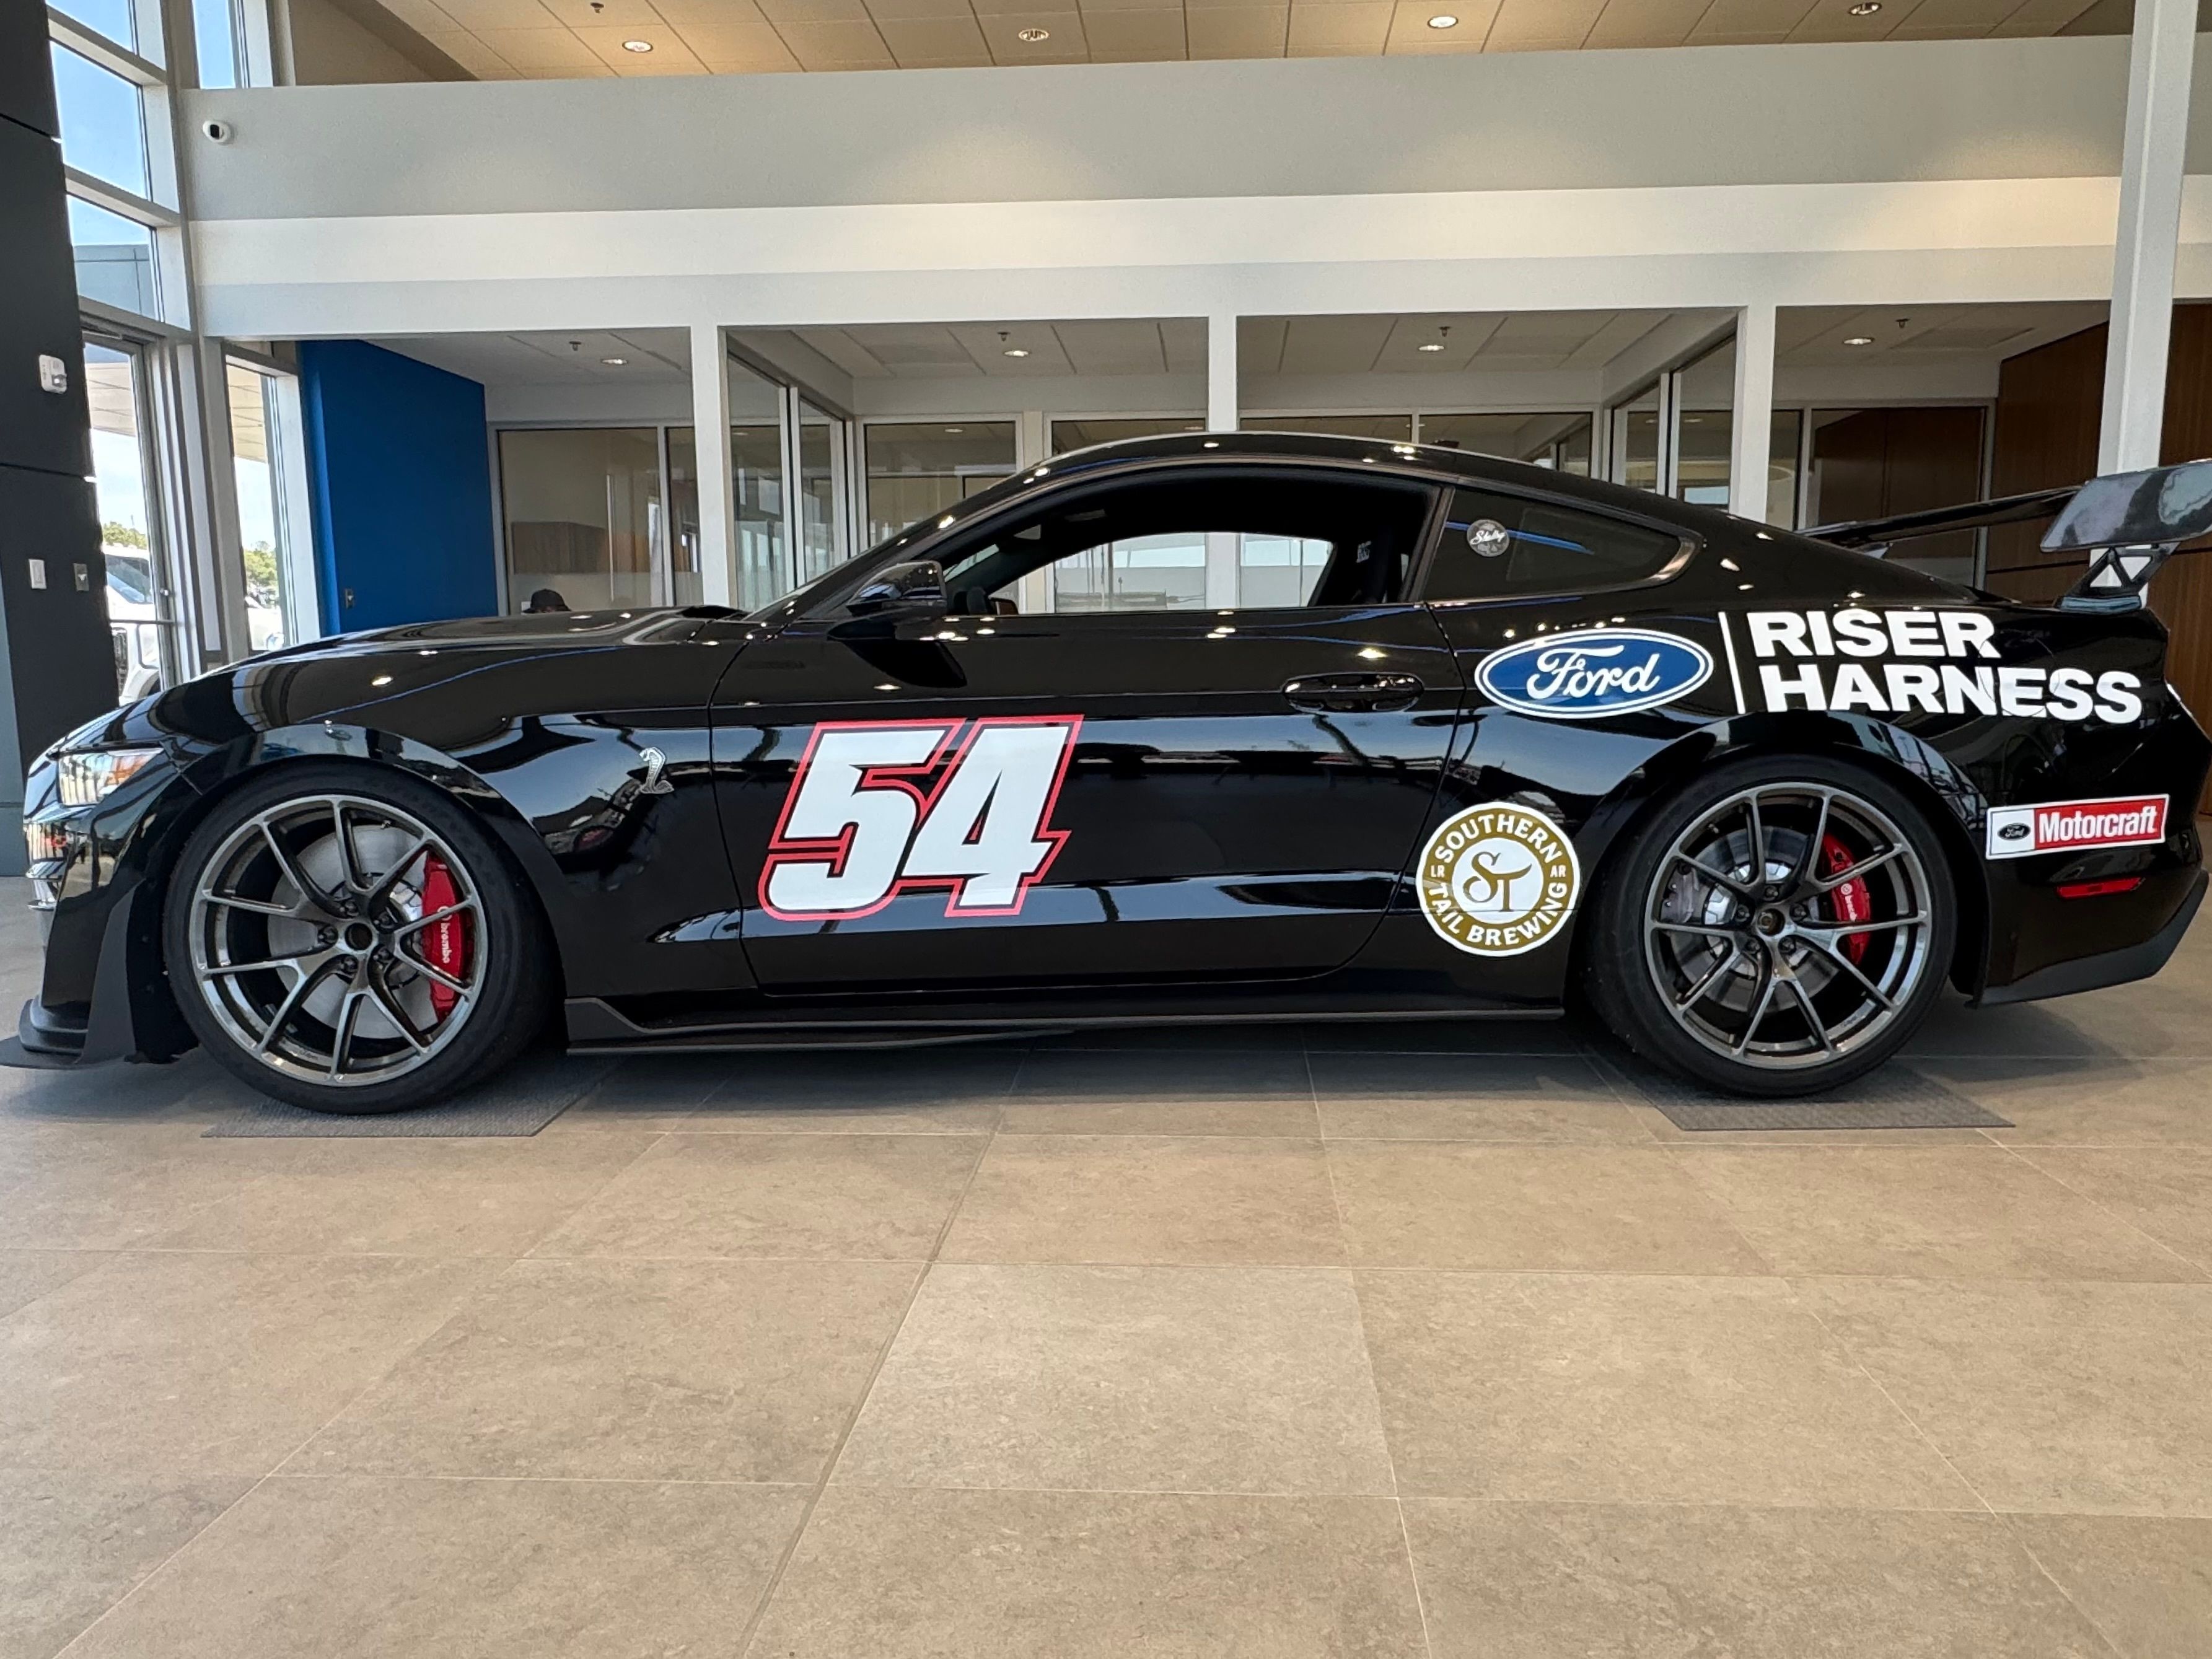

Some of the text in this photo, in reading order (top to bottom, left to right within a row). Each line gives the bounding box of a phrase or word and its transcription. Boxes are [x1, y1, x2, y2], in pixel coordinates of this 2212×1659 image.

[1747, 610, 2001, 658] RISER
[1526, 644, 1661, 699] Ford
[1759, 663, 2143, 724] HARNESS
[758, 714, 1084, 921] 54
[1434, 813, 1562, 864] SOUTHERN
[2039, 805, 2157, 843] Motorcraft
[1430, 865, 1445, 878] LR
[1550, 865, 1566, 878] AR
[1428, 882, 1568, 946] TAIL BREWING
